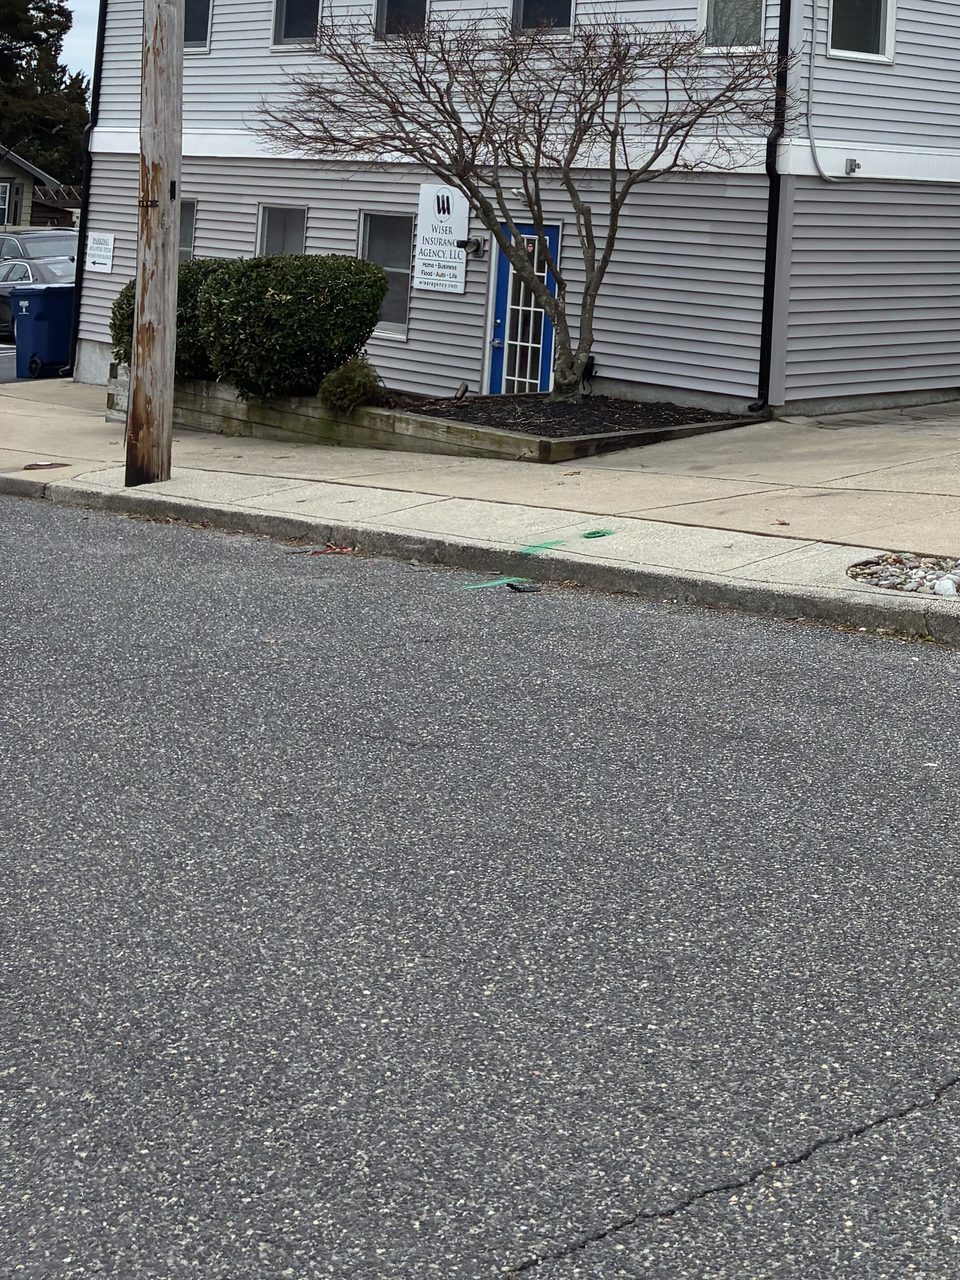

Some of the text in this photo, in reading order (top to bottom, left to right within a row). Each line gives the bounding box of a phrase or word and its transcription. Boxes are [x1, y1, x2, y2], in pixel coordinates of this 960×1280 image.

[431, 224, 453, 235] WISER
[422, 235, 458, 248] INSURANC
[449, 250, 464, 260] LLC
